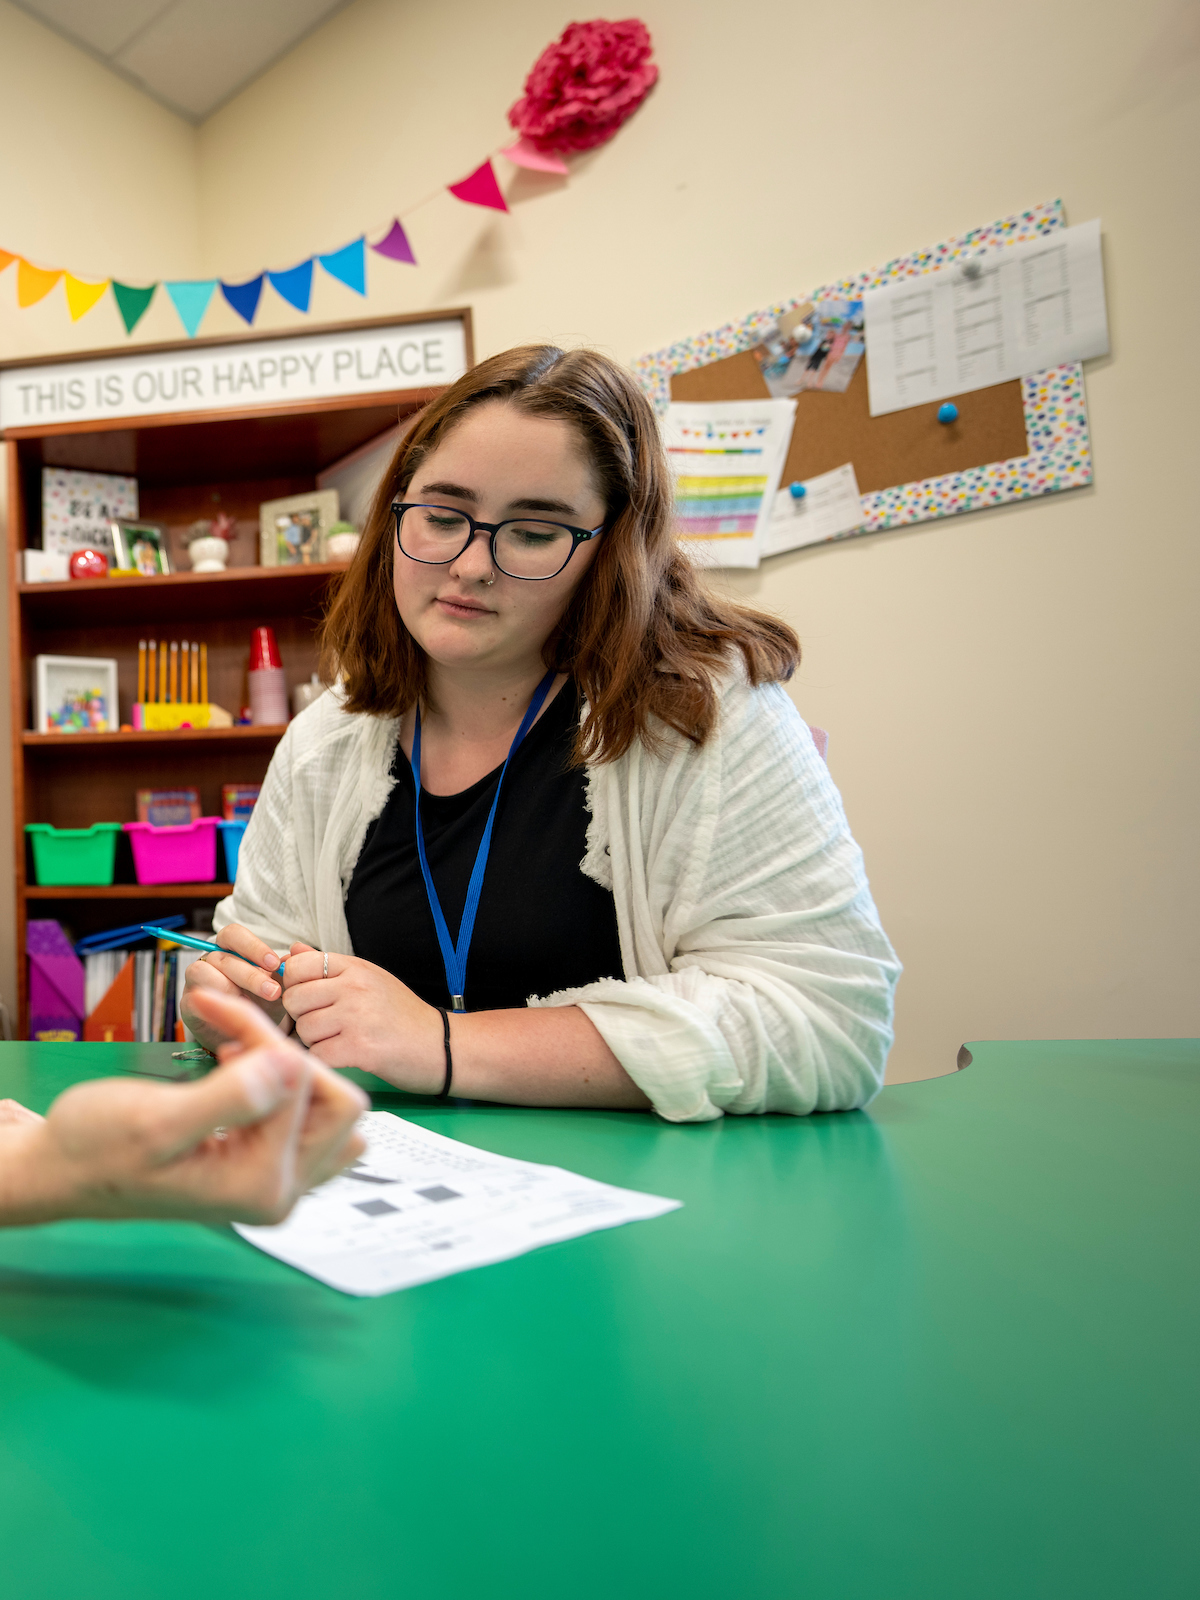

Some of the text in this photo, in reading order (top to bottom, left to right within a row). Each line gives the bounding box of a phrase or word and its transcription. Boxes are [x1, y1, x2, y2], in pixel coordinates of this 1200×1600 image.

[18, 339, 445, 415] THIS IS OUR HAPPY PLACE
